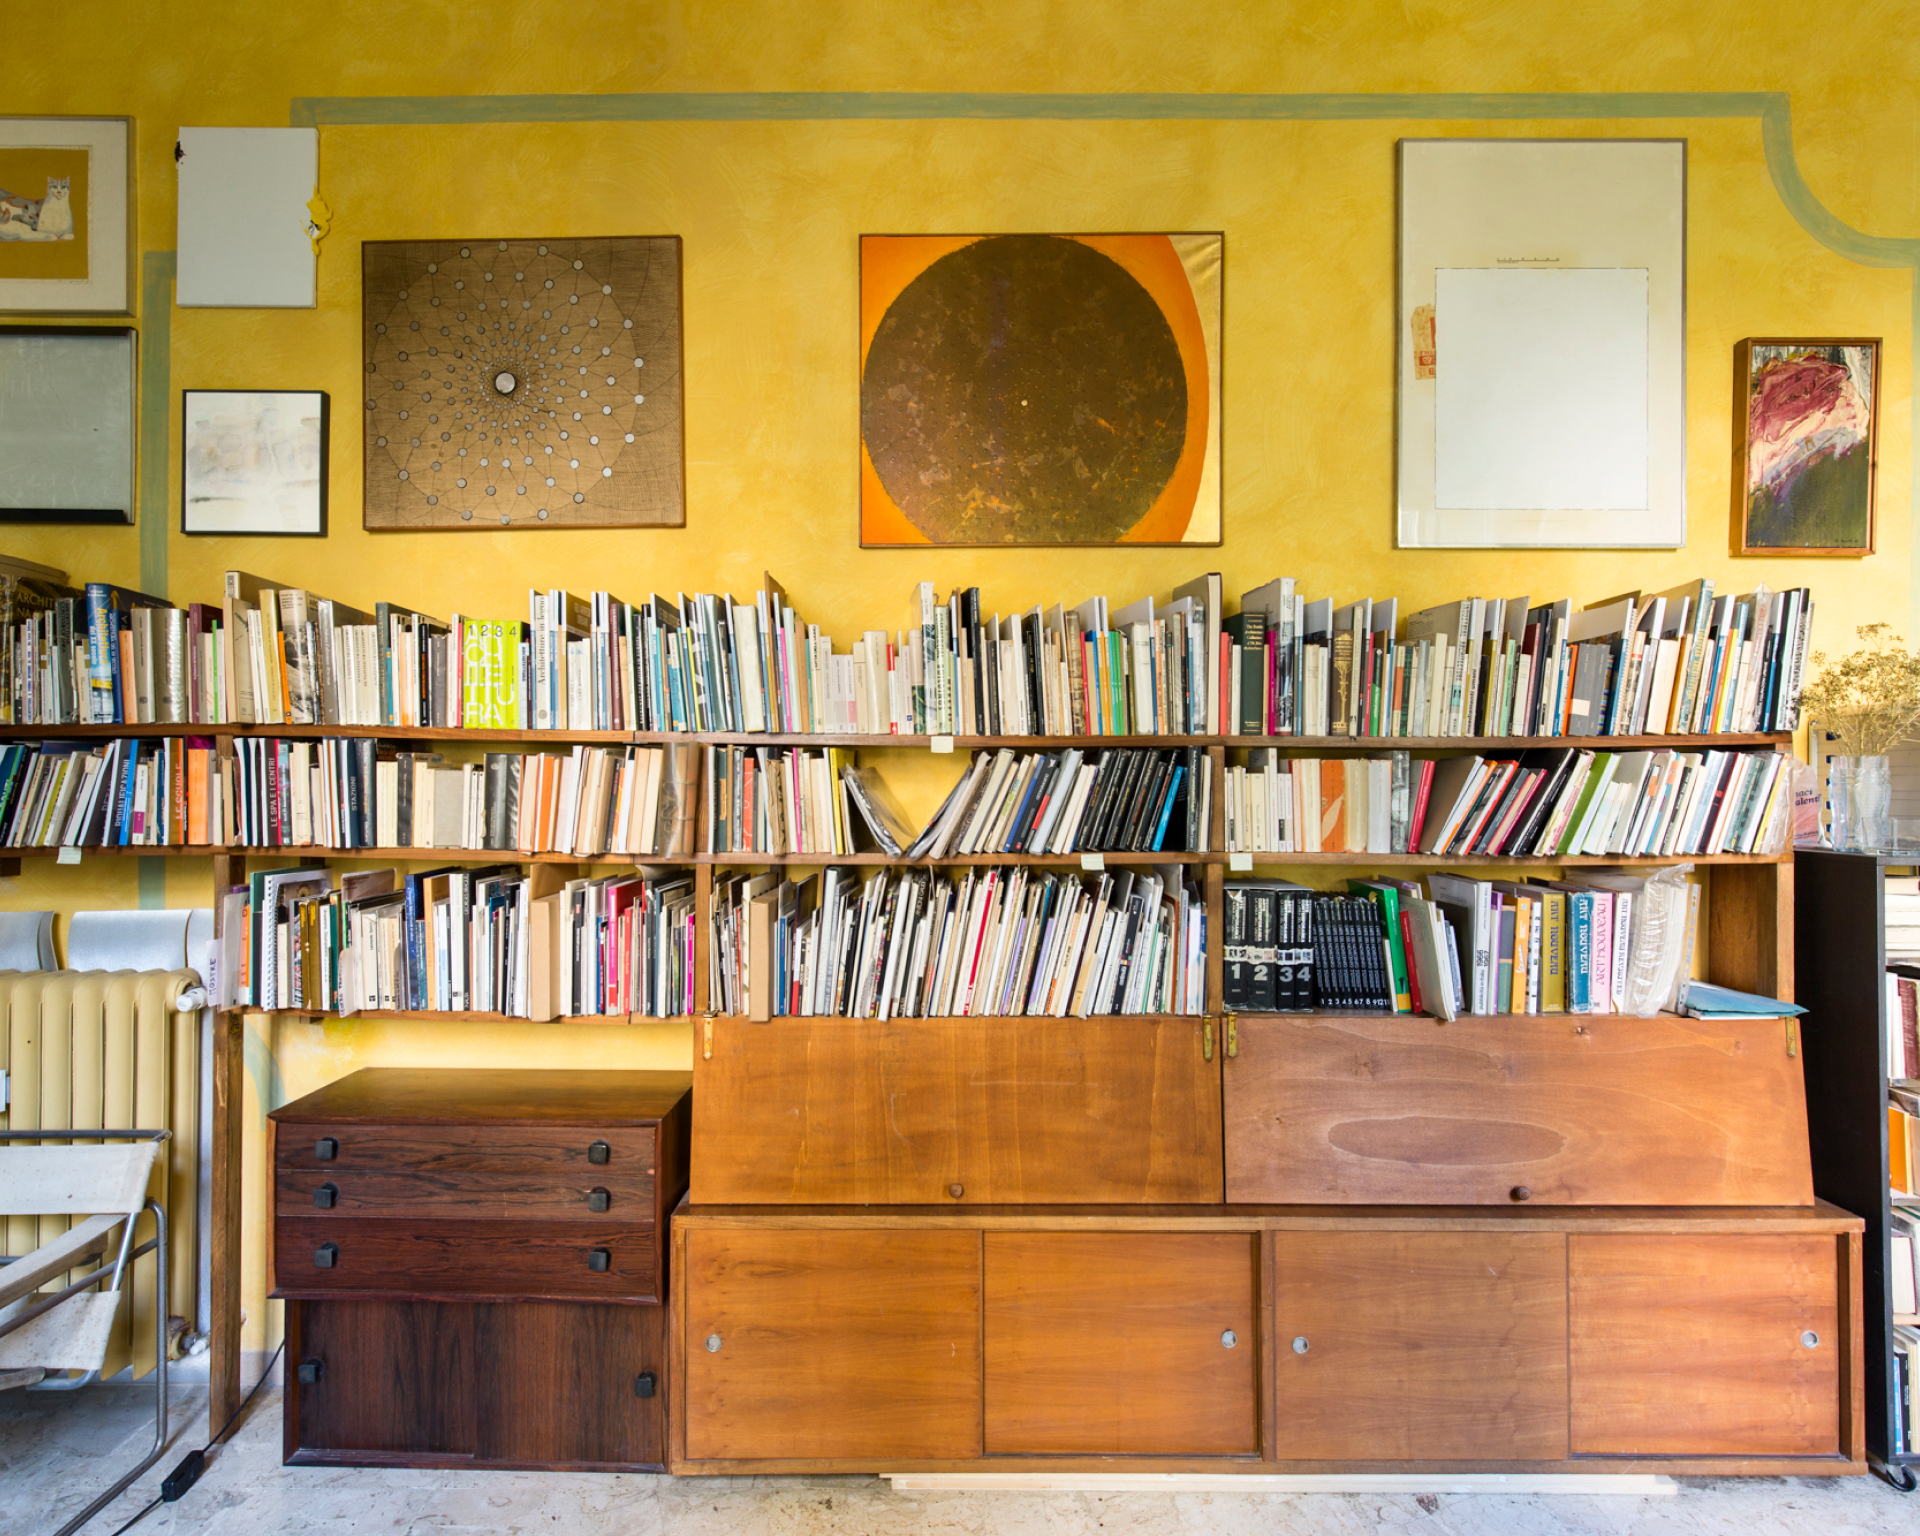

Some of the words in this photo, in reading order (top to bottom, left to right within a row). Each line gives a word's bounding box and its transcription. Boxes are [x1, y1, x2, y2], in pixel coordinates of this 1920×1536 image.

[536, 597, 546, 620] legno
[97, 608, 109, 665] Architettura
[481, 625, 489, 637] 2
[496, 626, 503, 638] 3
[509, 626, 518, 637] 4
[536, 633, 546, 686] Architetture
[1466, 690, 1475, 735] insediamenti
[268, 757, 277, 786] CENTRI
[350, 775, 358, 811] STAZIONI
[270, 798, 278, 816] SPA
[270, 816, 278, 828] LE
[1550, 900, 1559, 923] ART
[1579, 898, 1589, 921] ART
[1621, 898, 1629, 914] ART
[1619, 915, 1628, 951] NOUVEAU
[1550, 926, 1559, 976] NOUVEAU
[1580, 924, 1588, 975] NOUVEAU
[208, 957, 217, 996] MOSTRE
[1231, 964, 1241, 980] 1
[1254, 965, 1269, 982] 2
[1279, 966, 1294, 983] 3
[1296, 966, 1311, 982] 4
[1596, 959, 1607, 986] ART
